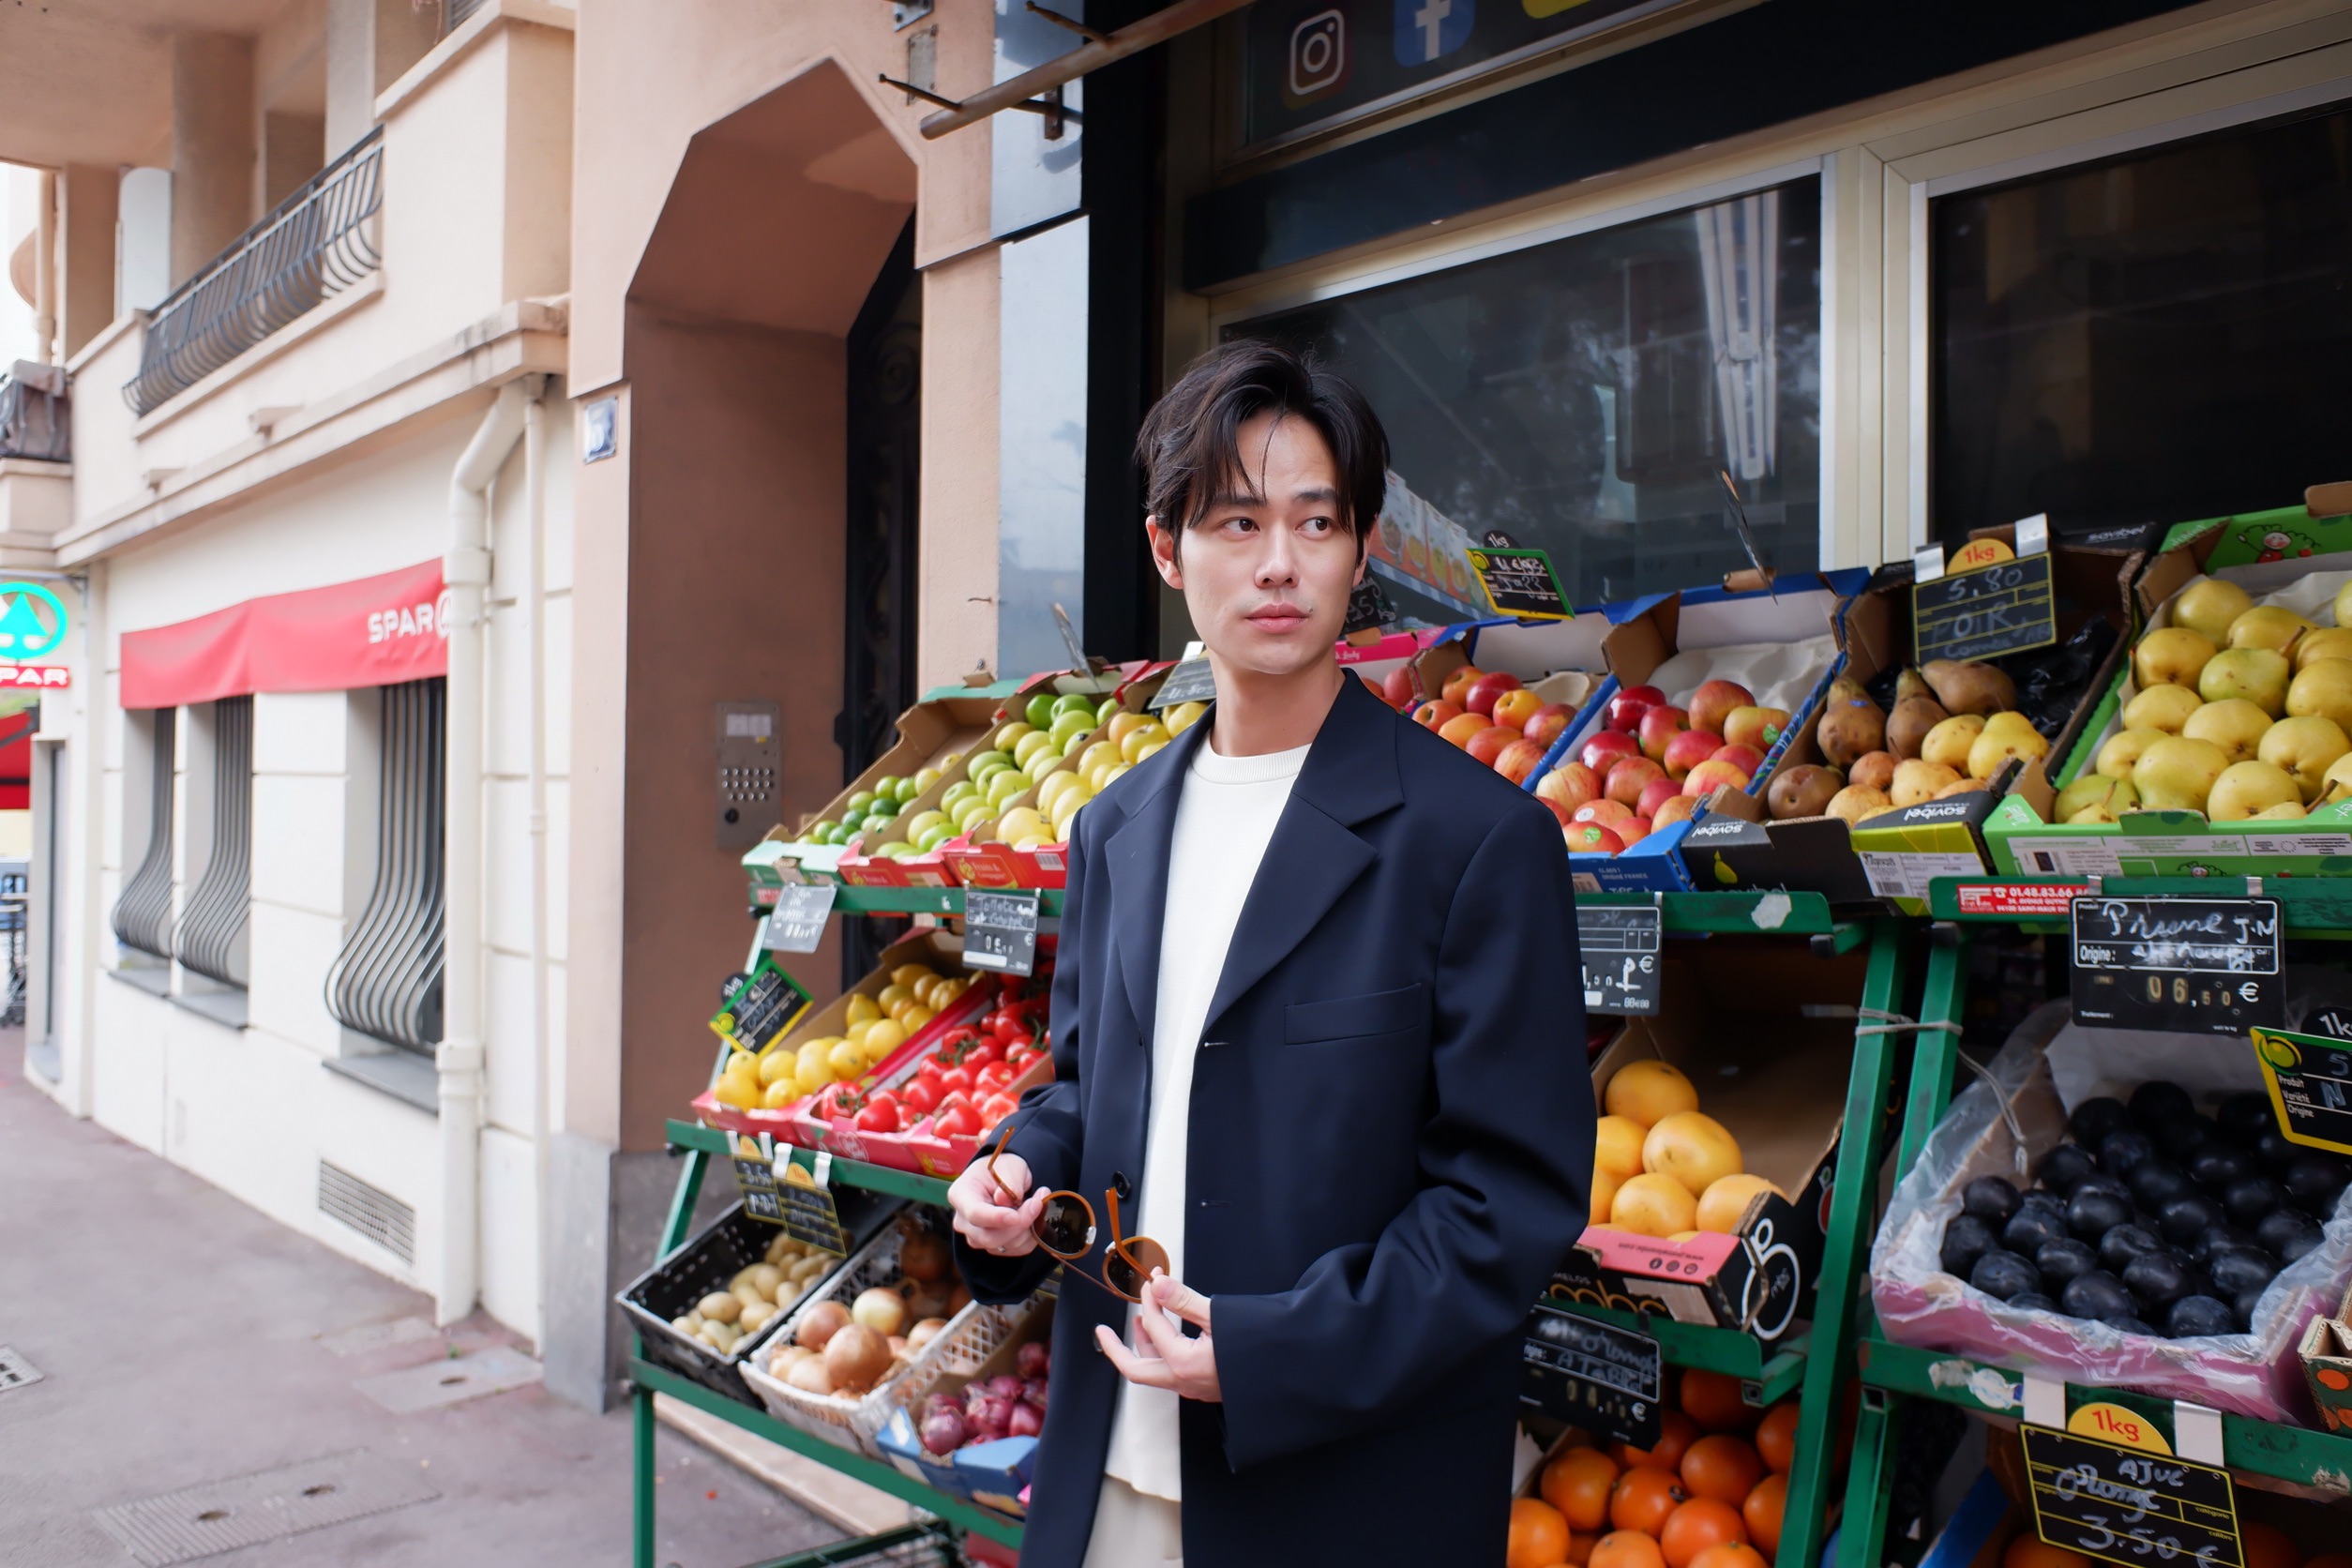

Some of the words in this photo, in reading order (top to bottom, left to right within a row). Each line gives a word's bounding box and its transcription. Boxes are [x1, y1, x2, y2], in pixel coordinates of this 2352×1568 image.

[1964, 546, 1996, 564] 1kg
[367, 601, 434, 644] SPAR
[0, 667, 68, 686] PAR
[1638, 955, 1654, 974] €
[2238, 981, 2259, 1003] €
[2318, 1012, 2352, 1036] 1k
[2277, 1074, 2305, 1089] Produit
[2282, 1090, 2312, 1105] Variété
[2285, 1104, 2315, 1119] Origine
[2091, 1409, 2141, 1443] 1kg
[2208, 1530, 2234, 1543] calibre
